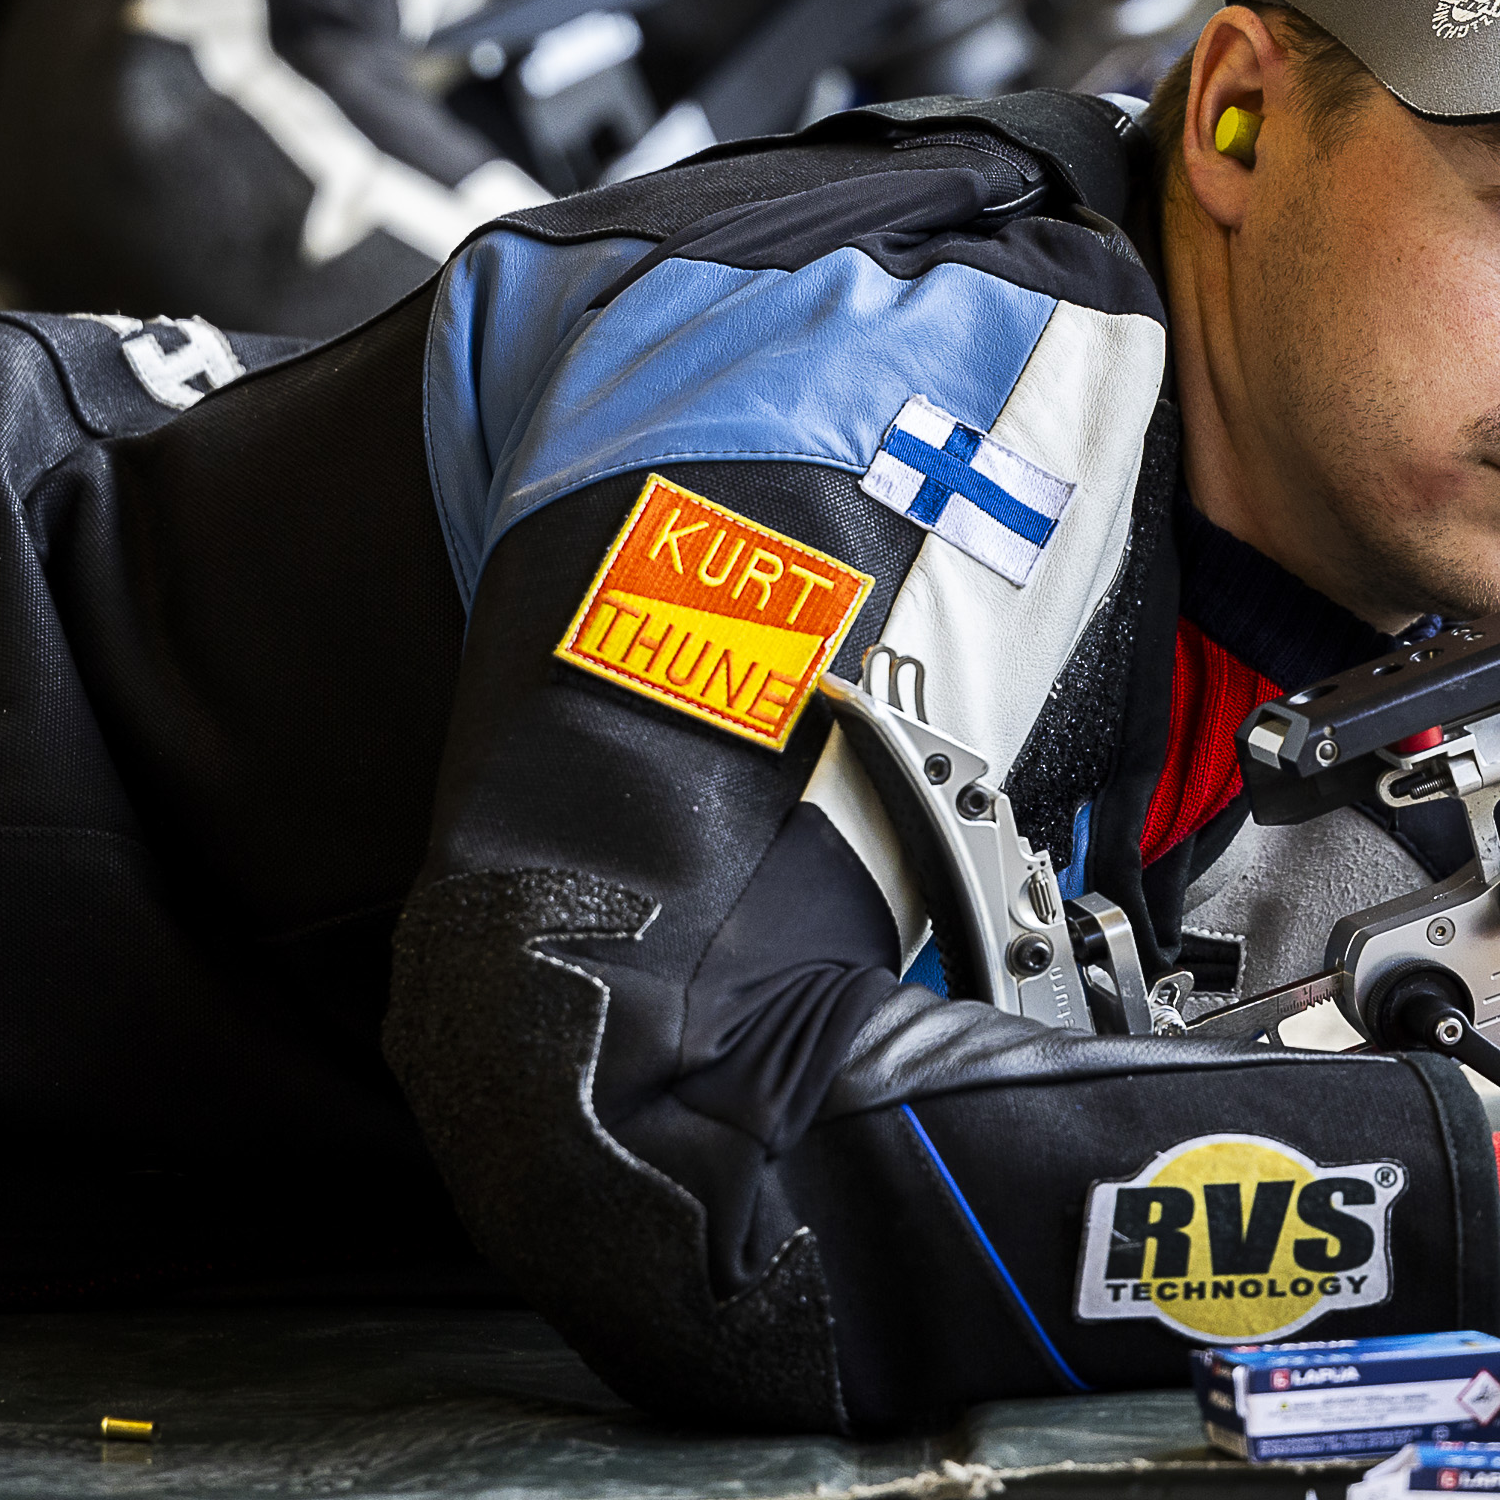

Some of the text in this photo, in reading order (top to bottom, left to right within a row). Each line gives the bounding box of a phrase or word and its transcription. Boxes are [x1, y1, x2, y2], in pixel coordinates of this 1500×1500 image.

[647, 507, 835, 626] KURT
[595, 603, 803, 727] THUNE
[1104, 1177, 1377, 1280] RVS
[1104, 1275, 1369, 1303] TECHNOLOGY
